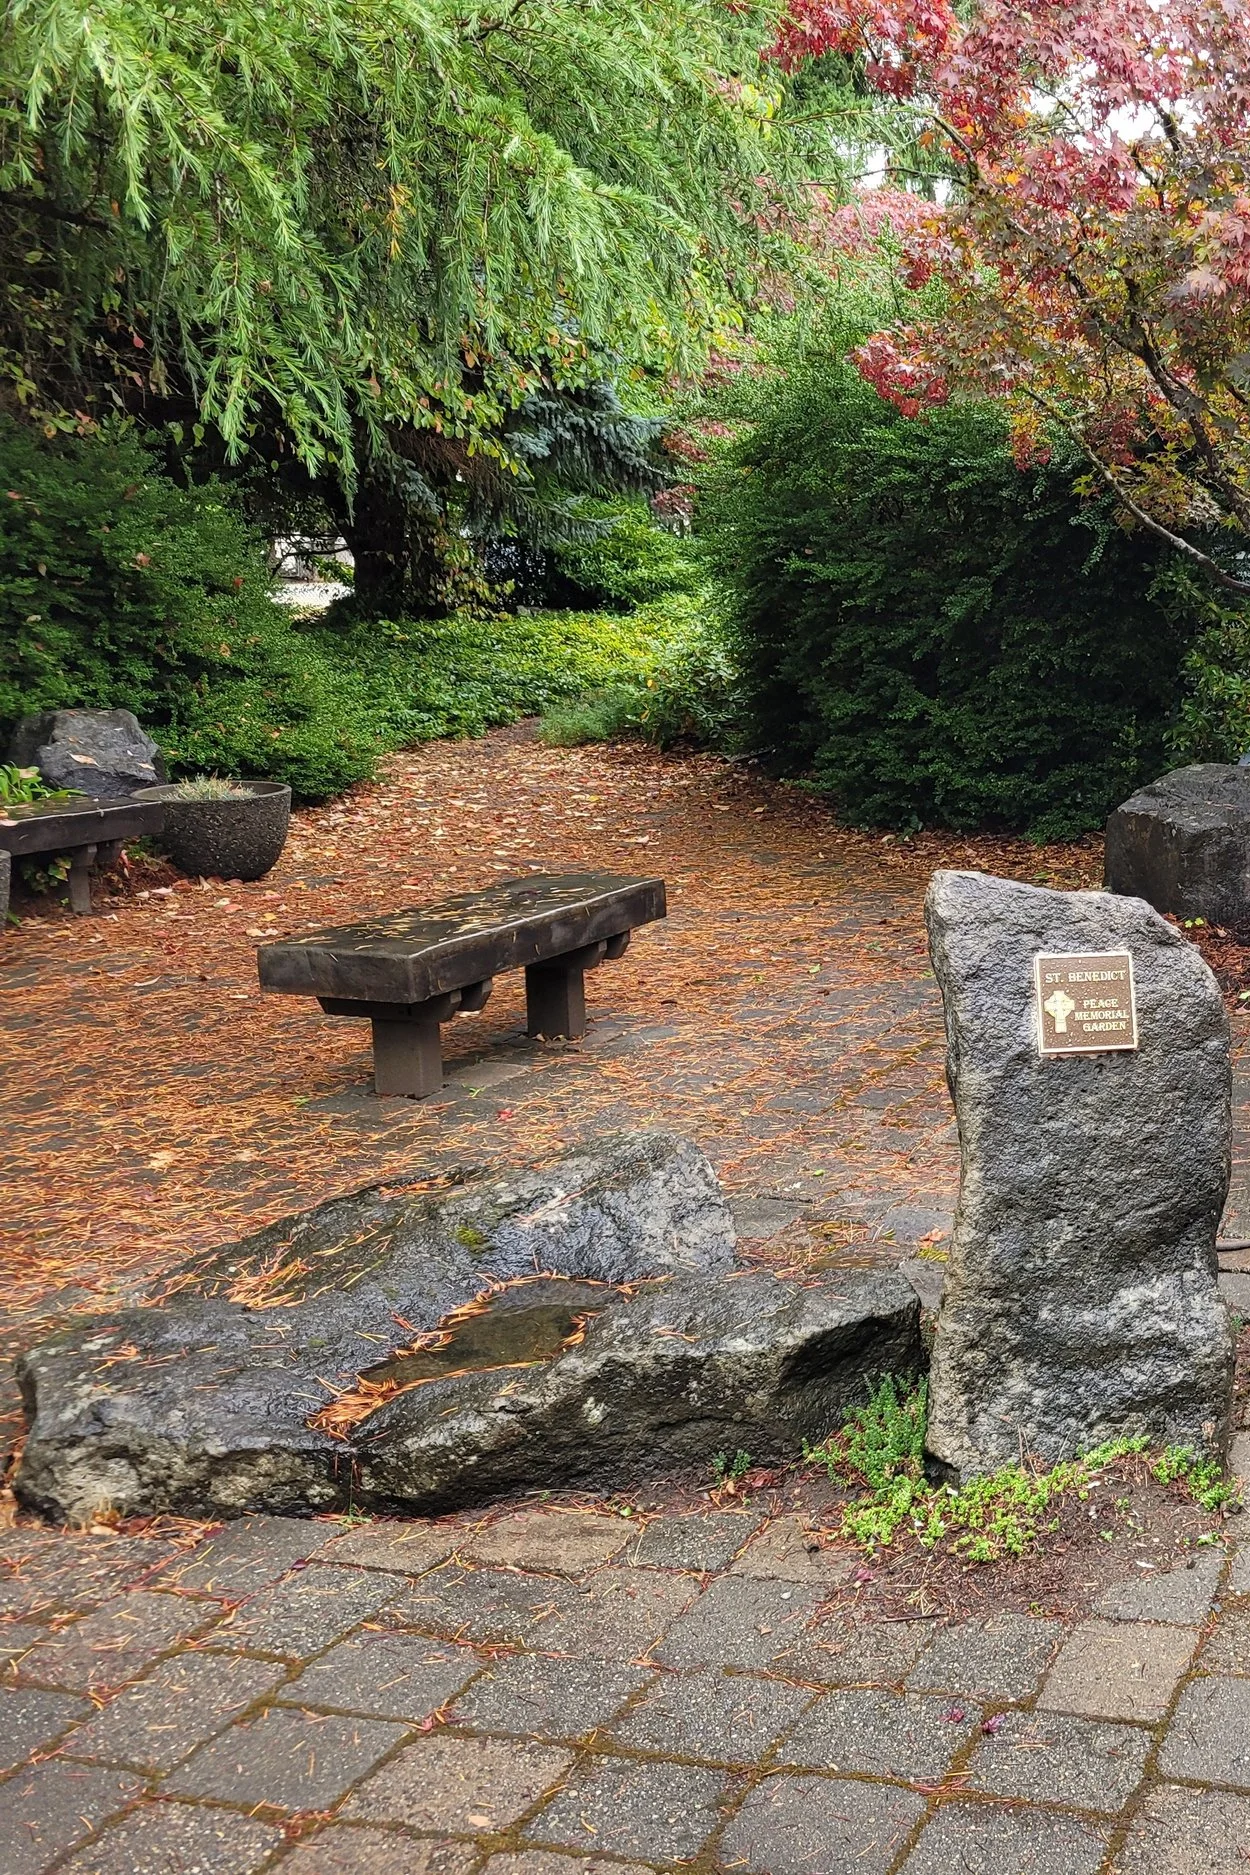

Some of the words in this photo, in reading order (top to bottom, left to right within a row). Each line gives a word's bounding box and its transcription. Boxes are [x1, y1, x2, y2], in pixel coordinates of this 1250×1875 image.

[1045, 973, 1064, 983] ST.
[1068, 970, 1126, 983] BENEDICT
[1083, 999, 1118, 1009] PEACE
[1075, 1010, 1129, 1021] MEMORIAL
[1083, 1022, 1126, 1032] GARDEN
